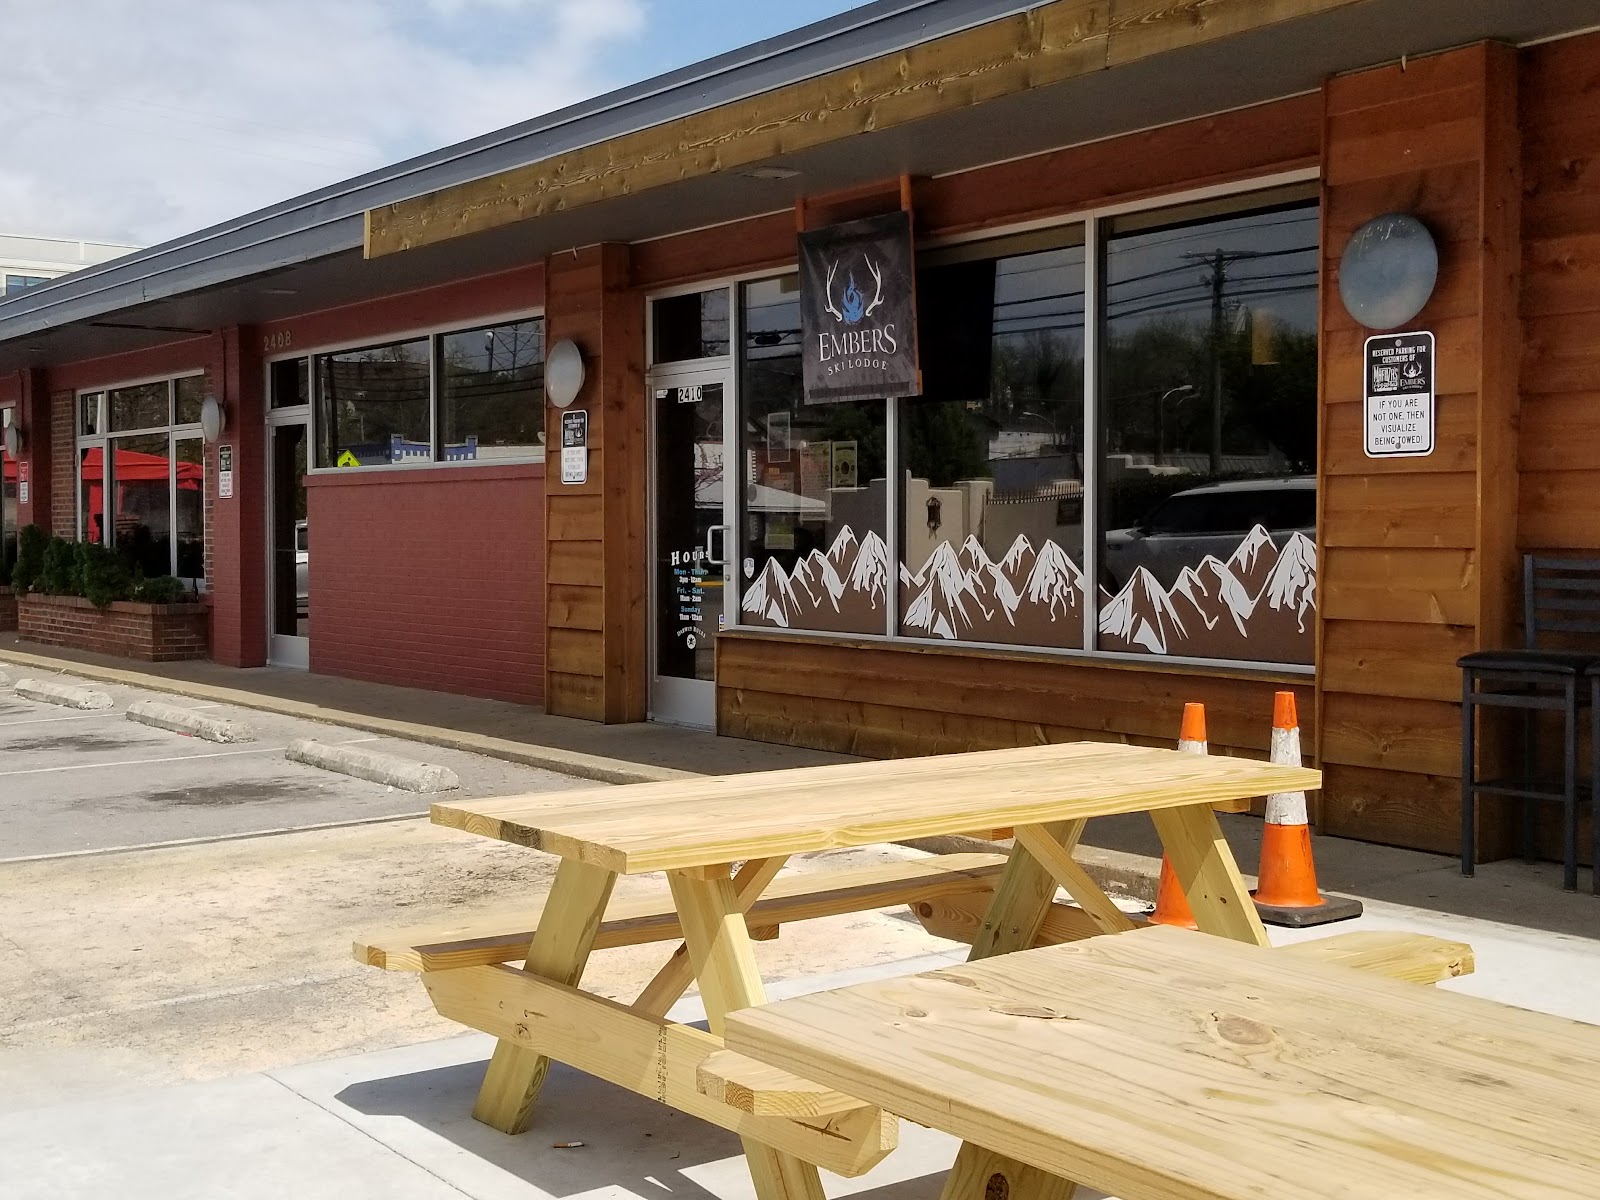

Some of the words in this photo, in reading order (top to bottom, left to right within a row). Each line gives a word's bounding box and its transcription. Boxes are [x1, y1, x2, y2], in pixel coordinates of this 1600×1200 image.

[263, 330, 291, 351] 2408
[818, 324, 897, 362] EMBERS
[1372, 349, 1394, 357] RESERVED
[1395, 346, 1416, 355] PARKING
[1416, 345, 1427, 353] FOR
[1382, 355, 1408, 363] CUSTOMERS
[1408, 353, 1416, 361] OF
[827, 362, 845, 376] SKI
[848, 359, 887, 371] LODGE
[679, 386, 702, 402] 2410
[1379, 400, 1386, 409] IF
[1387, 400, 1402, 408] YOU
[1404, 398, 1418, 407] ARE
[1373, 413, 1386, 421] NOT
[1388, 411, 1404, 421] ONE,
[1407, 411, 1424, 419] THEN
[1381, 424, 1416, 433] VISUALIZE
[1375, 437, 1395, 445] BEING
[1398, 435, 1423, 445] TOWED!
[681, 606, 700, 614] Sunday
